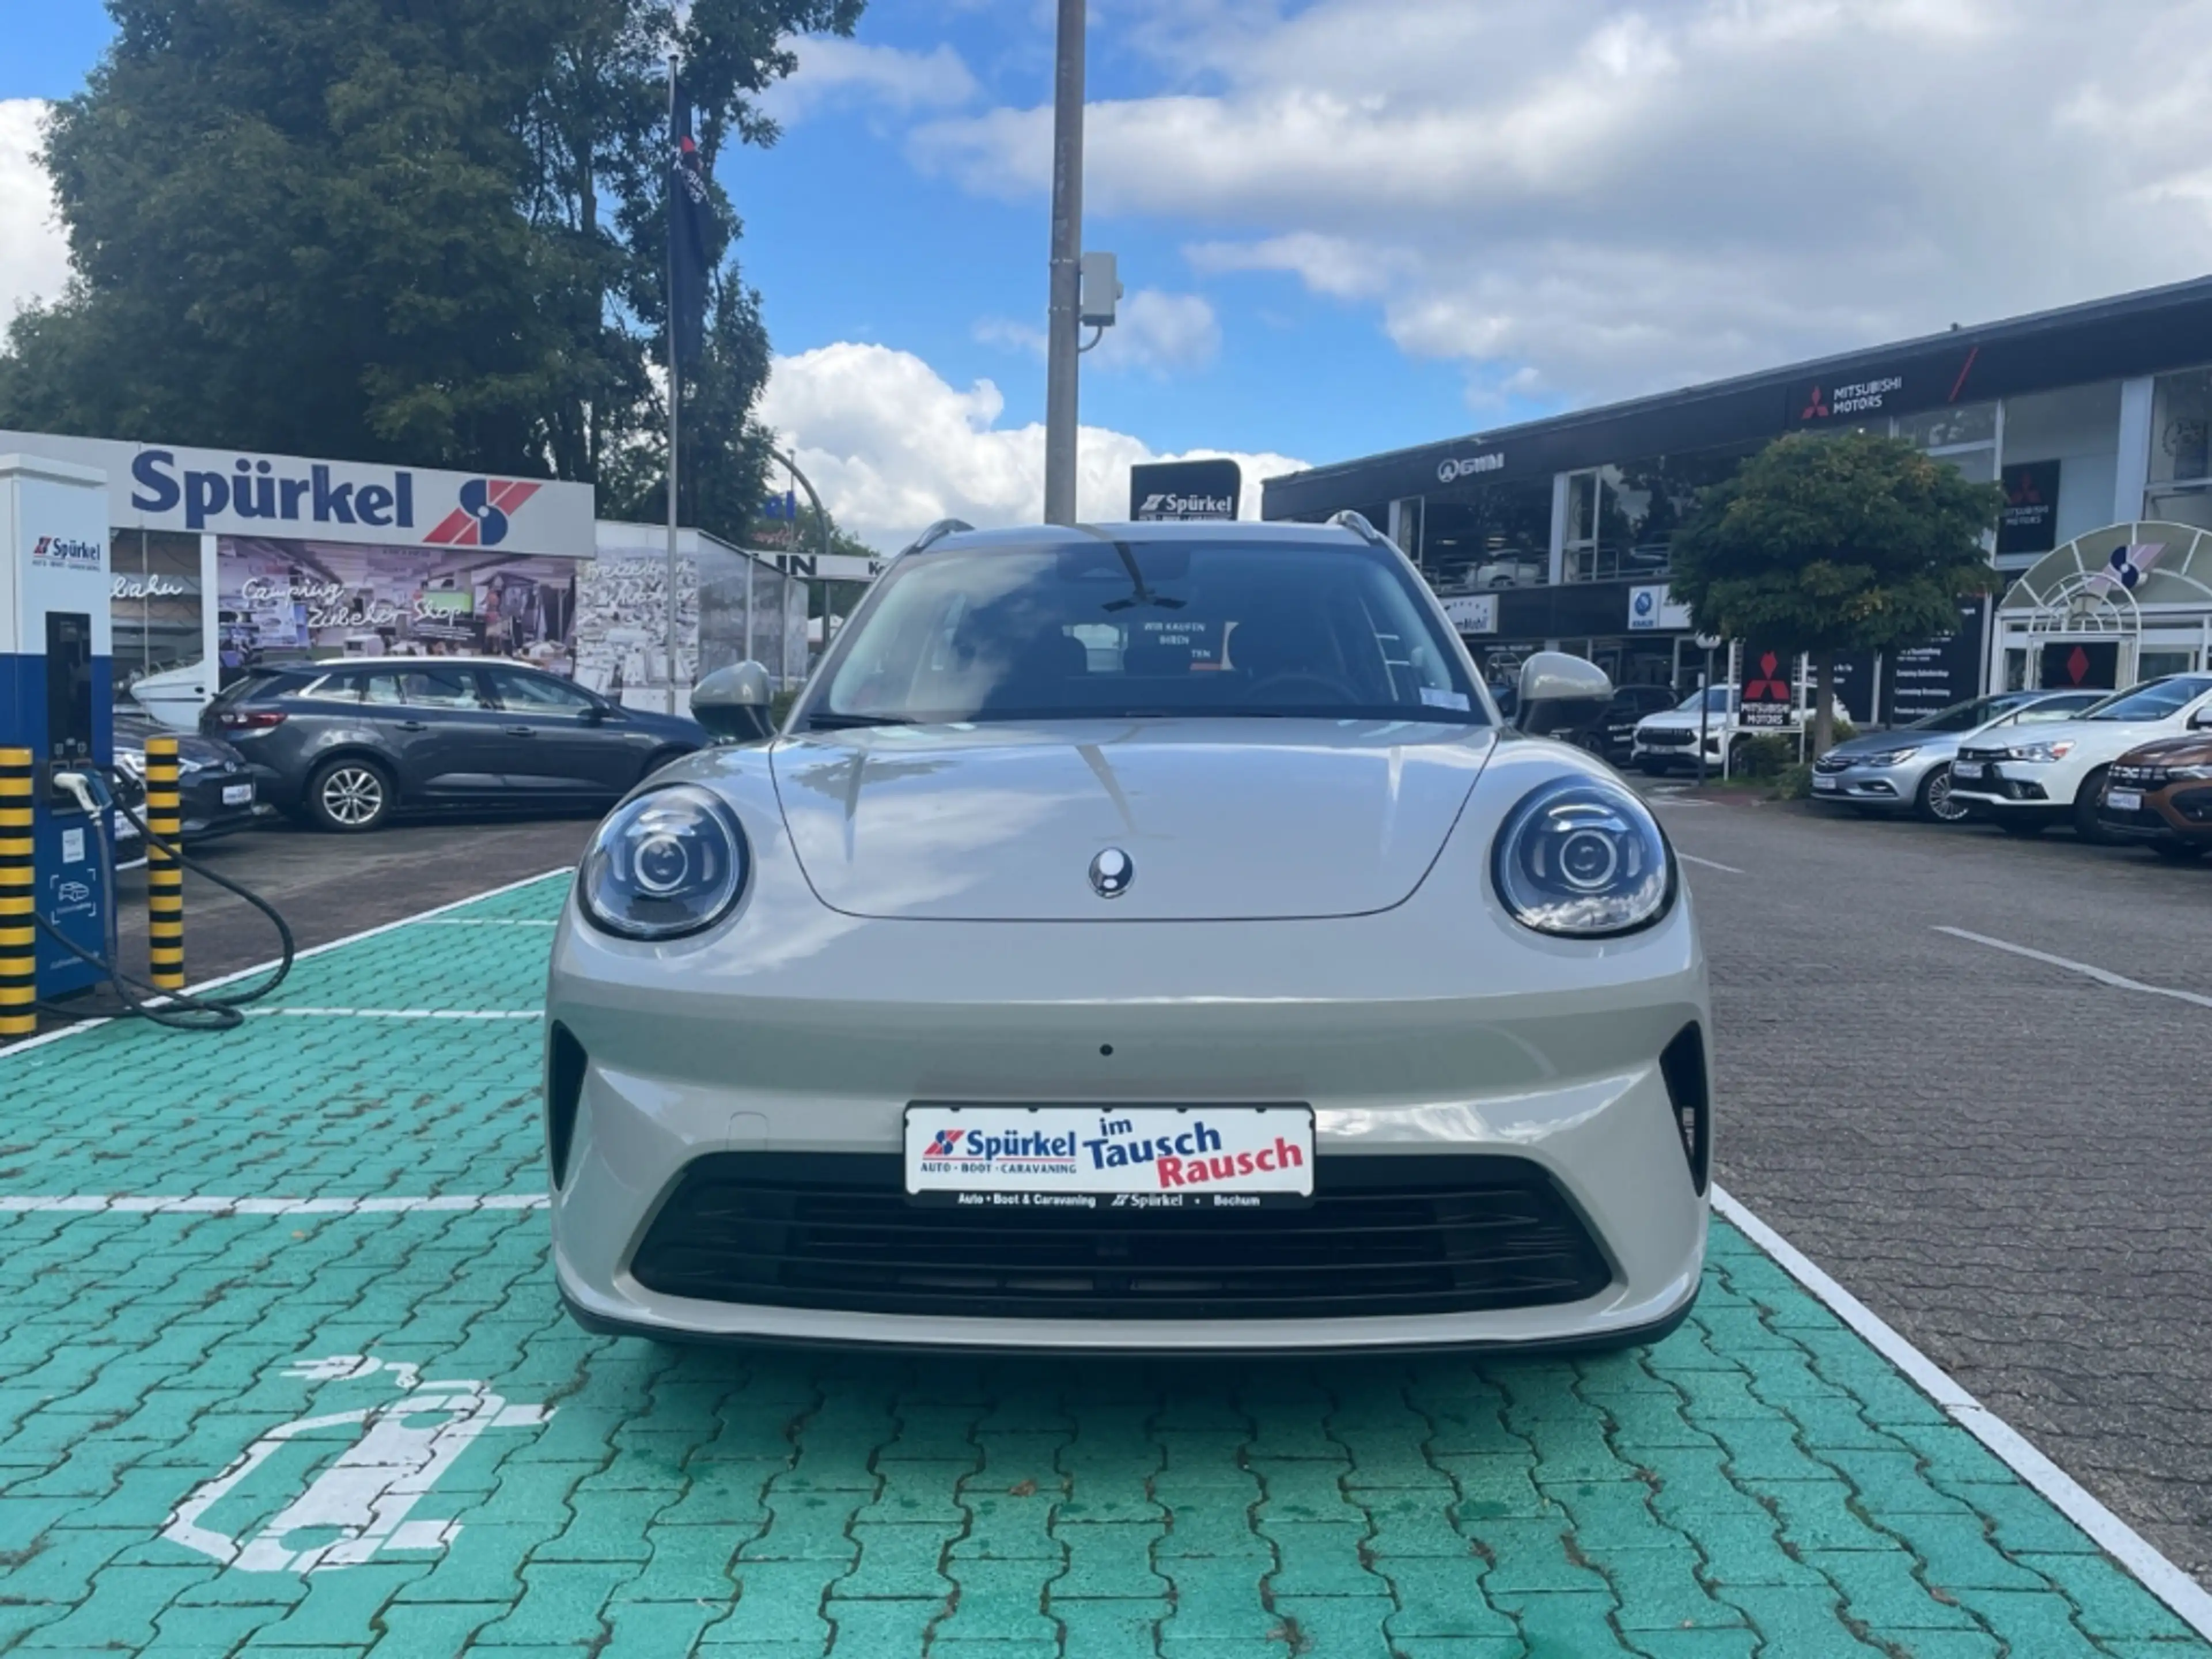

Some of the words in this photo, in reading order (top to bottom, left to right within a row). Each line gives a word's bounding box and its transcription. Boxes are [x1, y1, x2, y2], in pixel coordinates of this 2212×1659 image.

[1834, 376, 1902, 399] MITSUBISHI
[1833, 396, 1883, 414] MOTORS
[131, 450, 415, 530] Spürkel
[1166, 493, 1232, 514] Spürkel
[53, 537, 101, 560] Spürkel
[1741, 703, 1790, 713] MITSUBISHI
[1747, 714, 1783, 725] MOTORS
[1100, 1117, 1133, 1137] im
[966, 1130, 1076, 1161] Spürkel
[1082, 1121, 1222, 1169] Tausch
[921, 1162, 951, 1173] AUTO
[961, 1163, 993, 1173] BOOT
[1000, 1164, 1077, 1174] CARAVANING
[1156, 1137, 1304, 1188] Rausch
[958, 1193, 984, 1205] Auto
[993, 1194, 1020, 1205] Boot
[1033, 1194, 1096, 1209] Caravaning
[1130, 1194, 1183, 1209] Spürkel
[1214, 1195, 1260, 1206] Bochum
